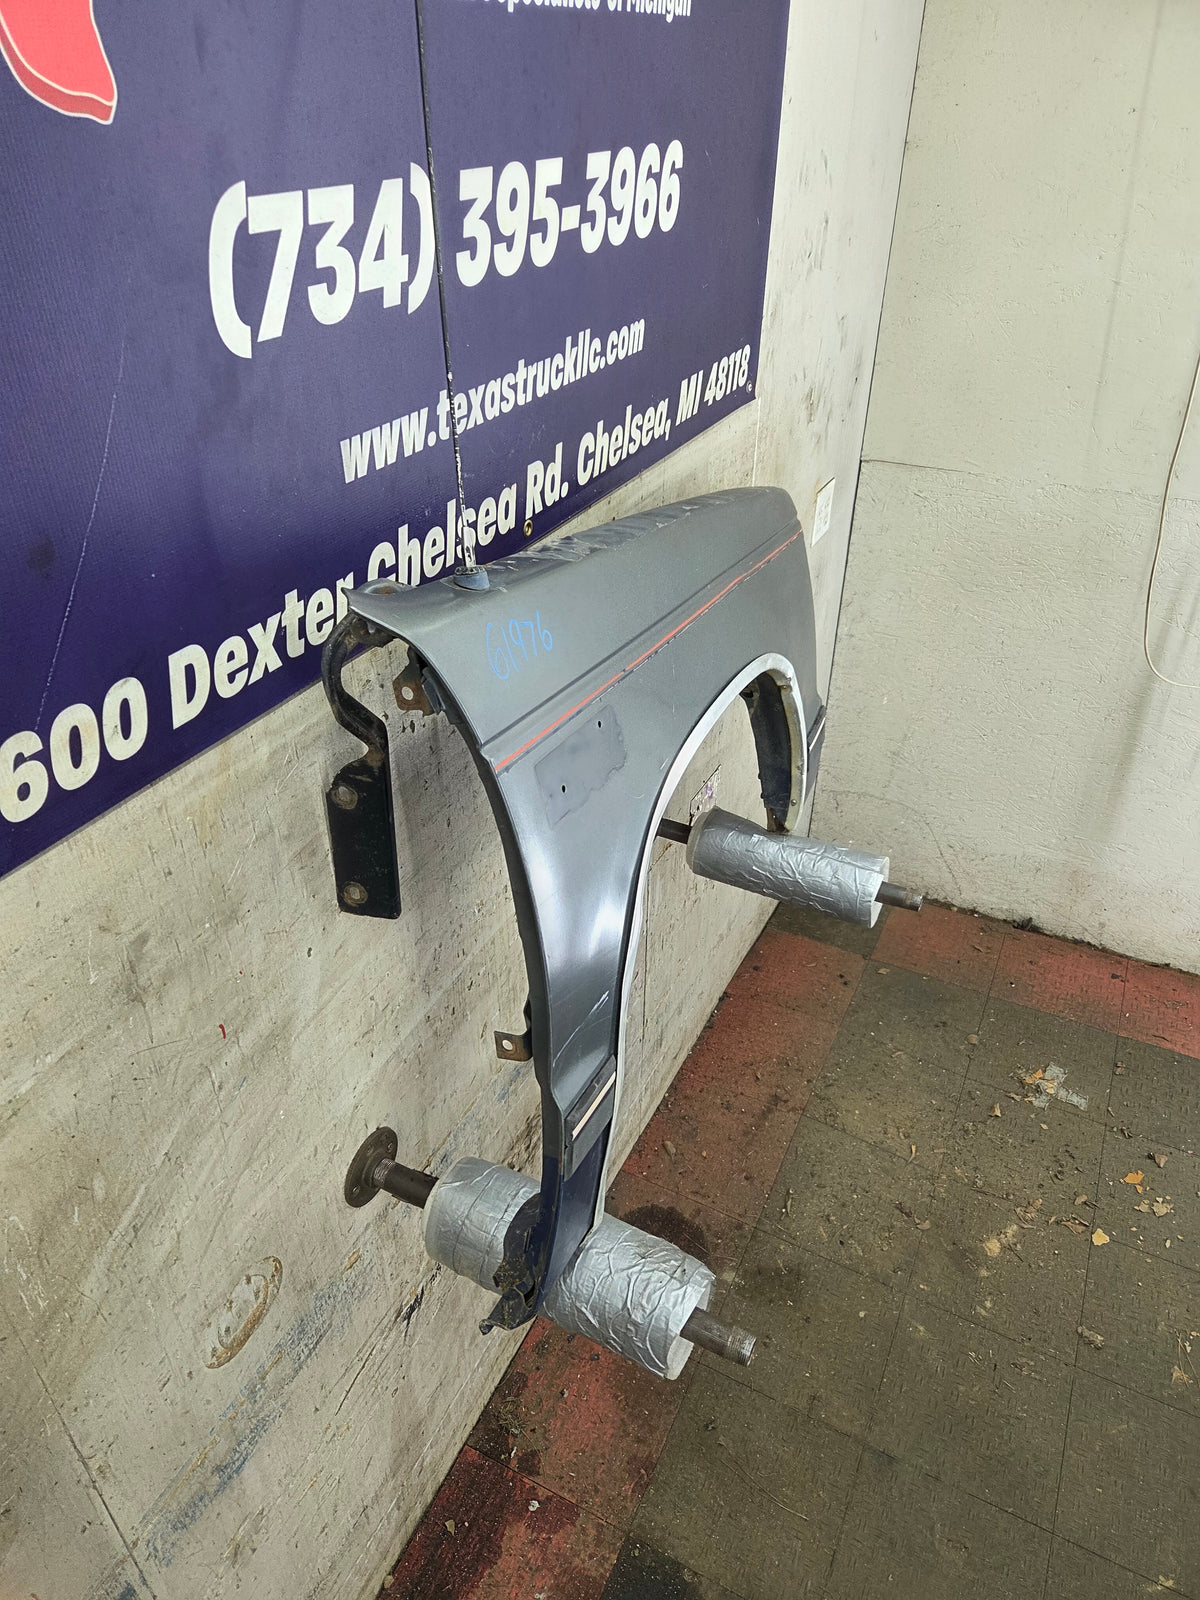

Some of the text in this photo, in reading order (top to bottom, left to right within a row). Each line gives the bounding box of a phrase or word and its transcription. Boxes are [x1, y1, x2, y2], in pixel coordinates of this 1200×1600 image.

[208, 139, 684, 359] (734) 395-3966
[340, 318, 645, 484] www.texastruckllc.com
[167, 571, 354, 730] Dexter
[367, 483, 517, 588] Chelsea
[525, 441, 569, 520] Rd.
[577, 398, 671, 486] Chelsea,
[676, 370, 704, 426] MI
[704, 344, 751, 406] 48118
[486, 609, 553, 680] 61976
